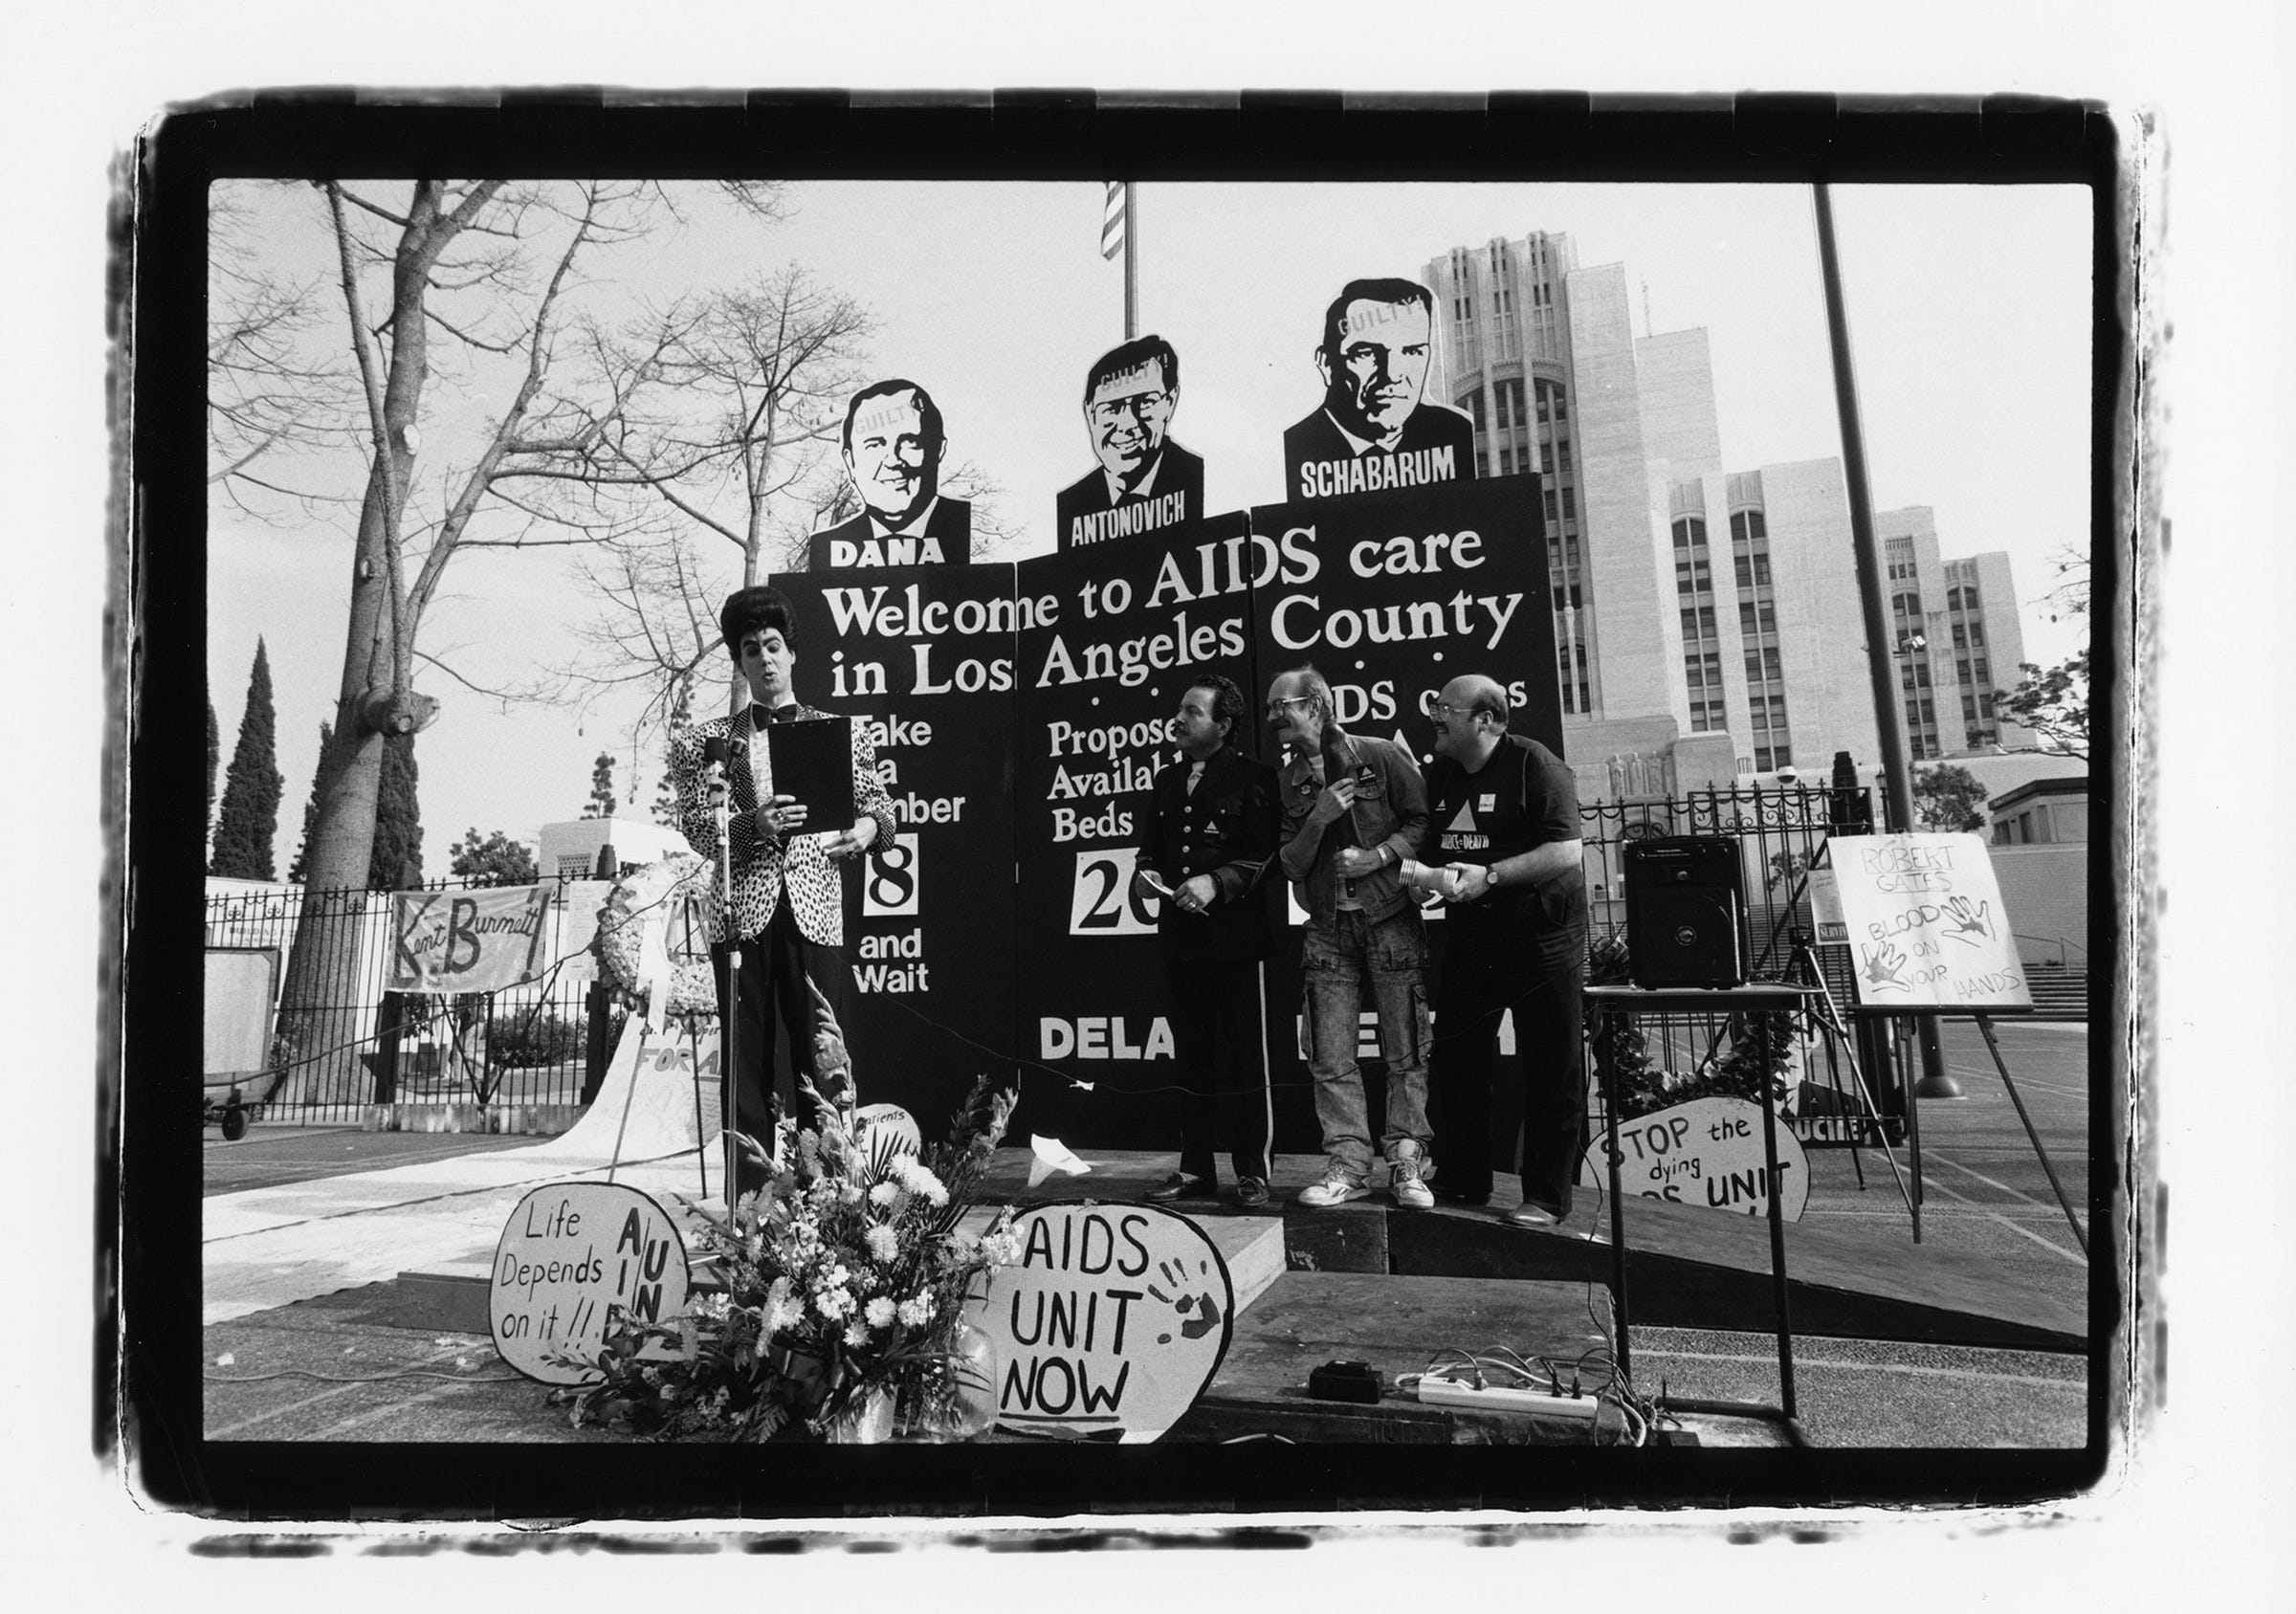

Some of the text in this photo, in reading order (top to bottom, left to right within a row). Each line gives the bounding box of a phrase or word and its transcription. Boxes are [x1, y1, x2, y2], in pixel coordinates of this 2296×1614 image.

[1338, 295, 1423, 336] GUILTY!
[1101, 353, 1168, 390] GUILTY!
[854, 398, 925, 434] GUILTY!
[1300, 445, 1456, 498] SCHABARUM
[1071, 490, 1184, 547] ANTONOVICH
[830, 537, 946, 567] DANA
[821, 524, 1486, 637] Welcome to AIDS care
[830, 589, 1523, 696] in Los Angeles County
[1331, 680, 1397, 724] DS
[1047, 719, 1178, 760] Propose
[877, 759, 898, 785] a
[1047, 750, 1182, 799] Availa
[893, 791, 965, 824] ber
[1052, 801, 1134, 842] Beds
[869, 843, 914, 908] 8
[1862, 845, 1955, 873] ROBERT
[1877, 872, 1953, 892] GATES
[393, 894, 447, 980] Kent
[1868, 905, 1941, 941] BLOOD
[859, 928, 921, 959] and
[1913, 940, 1940, 958] ON
[851, 963, 929, 993] Wait
[1902, 965, 1948, 987] YOUR
[1954, 968, 2020, 999] HANDS
[1040, 1017, 1176, 1060] DELA
[638, 1048, 694, 1072] FOR
[865, 1111, 905, 1125] atients
[1601, 1117, 1751, 1167] STOP the
[1649, 1158, 1701, 1183] dying
[525, 1199, 581, 1238] Life
[1023, 1214, 1149, 1277] AIDS
[500, 1245, 603, 1302] Depends
[501, 1314, 529, 1338] on
[539, 1304, 559, 1339] it
[1010, 1289, 1143, 1355] UNIT
[1001, 1356, 1130, 1415] NOW
